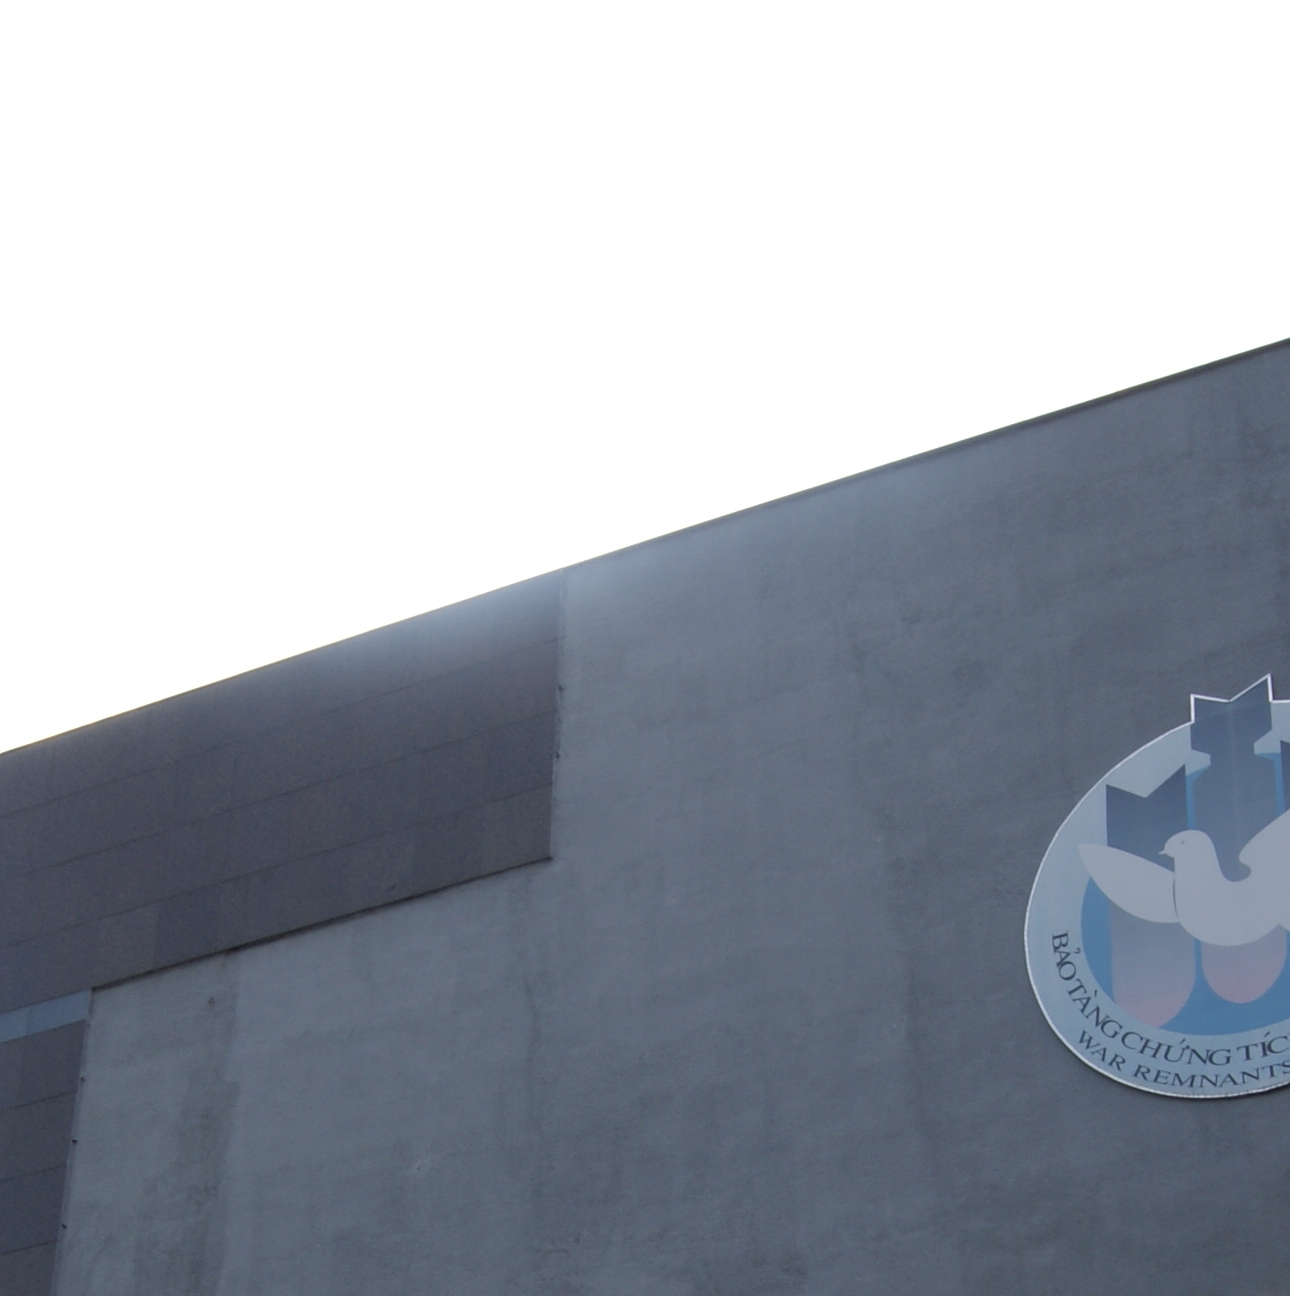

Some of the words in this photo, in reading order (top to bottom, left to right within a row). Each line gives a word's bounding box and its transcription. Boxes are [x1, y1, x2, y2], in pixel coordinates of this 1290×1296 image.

[1052, 931, 1081, 981] BẢO
[1068, 978, 1123, 1039] TÀNG
[1122, 1032, 1231, 1066] CHỨNG
[1078, 1031, 1126, 1071] WAR
